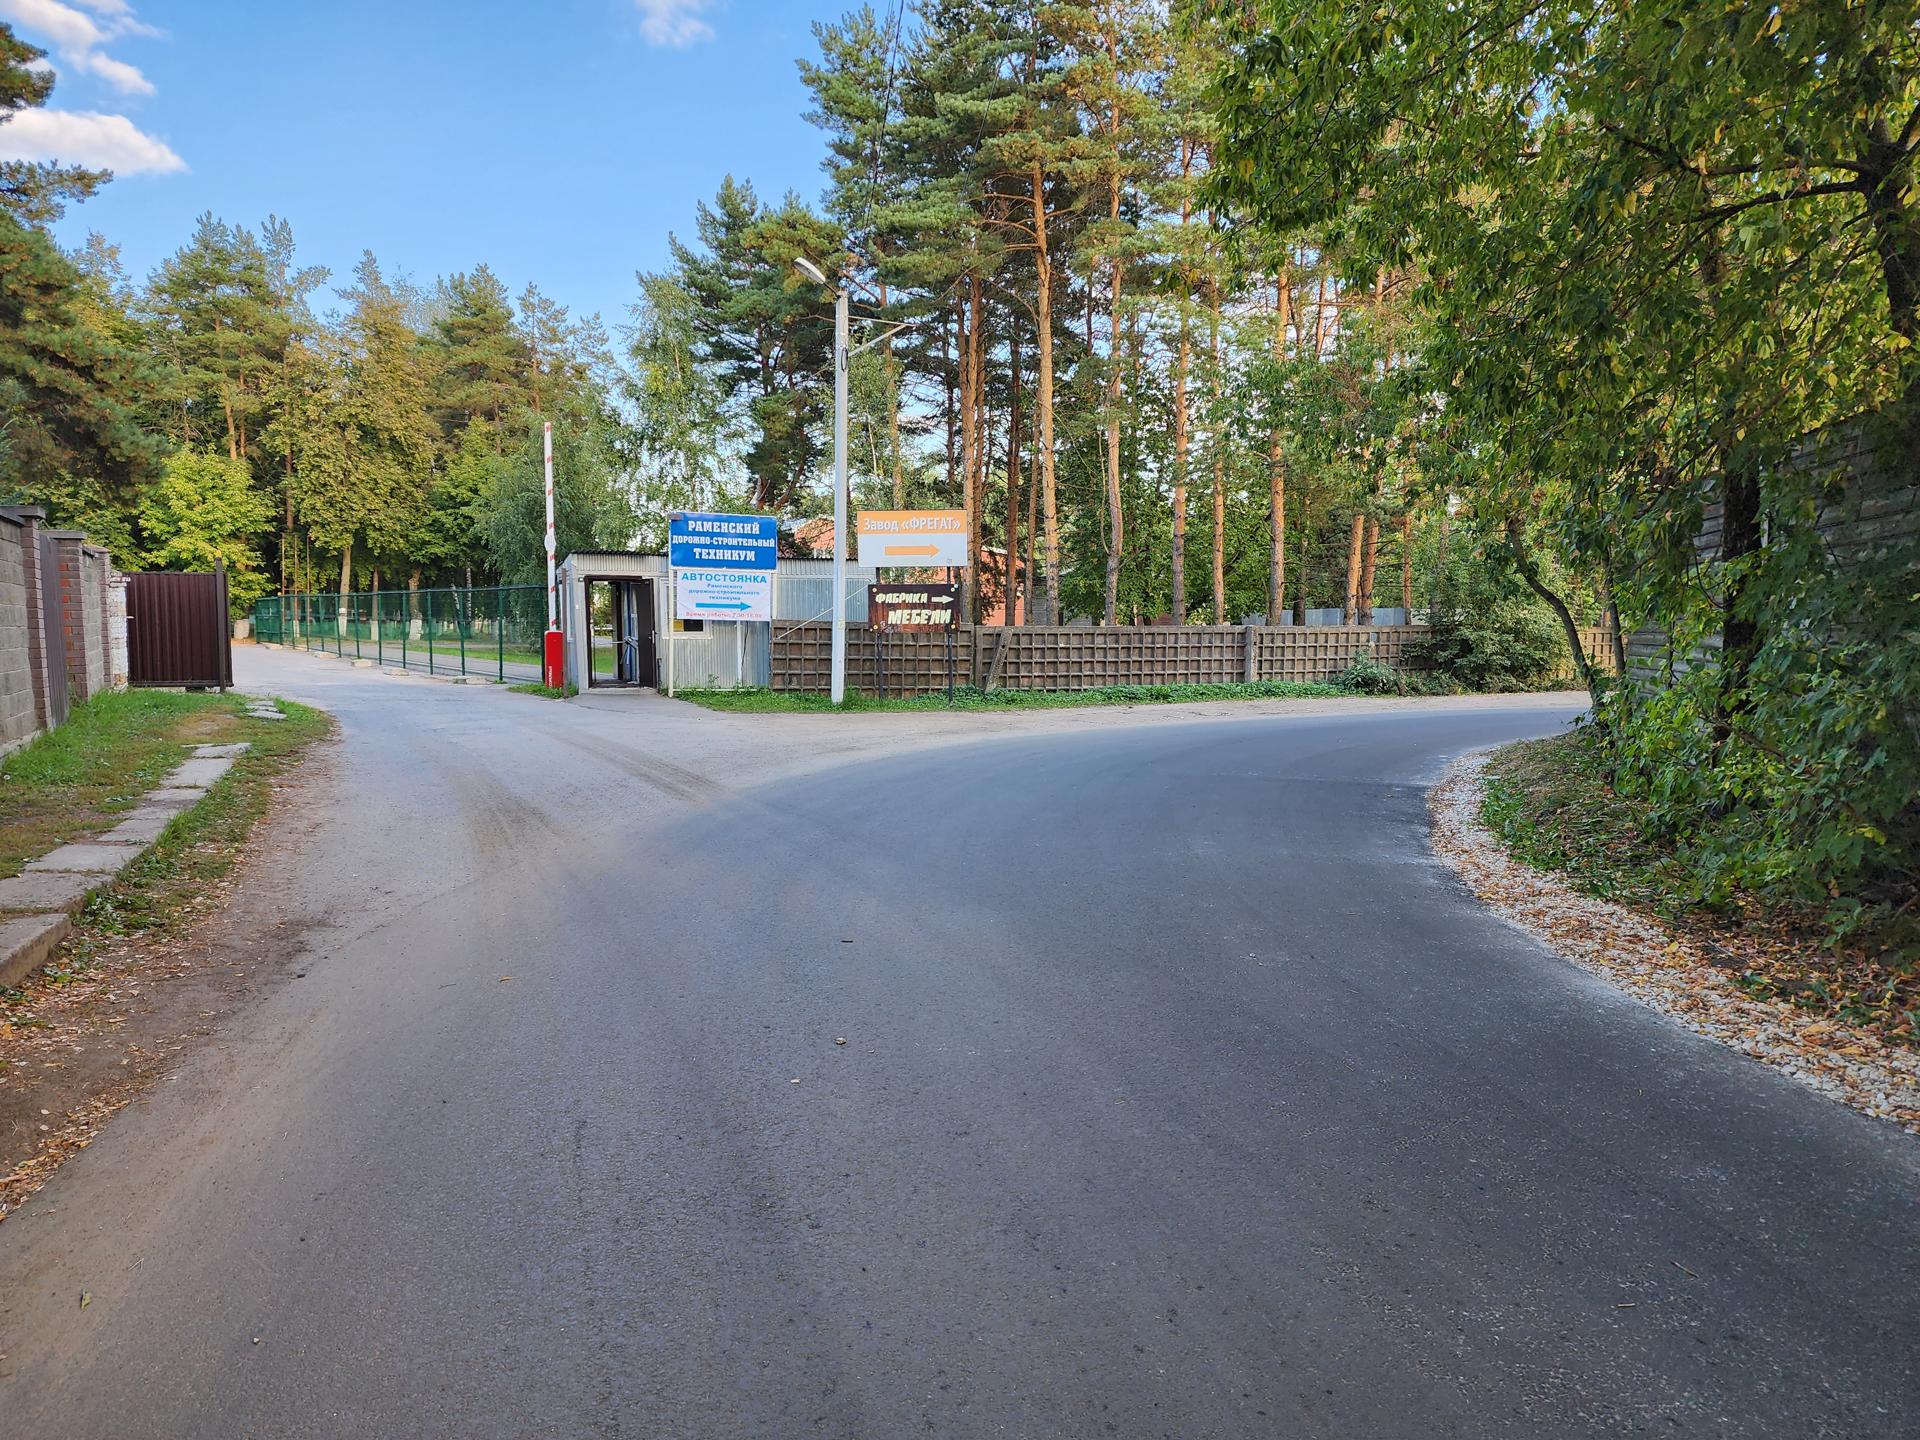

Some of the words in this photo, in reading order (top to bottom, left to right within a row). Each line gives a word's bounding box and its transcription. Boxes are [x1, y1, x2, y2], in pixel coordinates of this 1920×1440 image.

[688, 520, 760, 534] РАМЕНСКИЙ
[863, 518, 899, 531] Завод
[902, 517, 961, 530] «ФРЕГАТ»
[672, 535, 775, 547] ДОРОЖНО-СТРОИТЕЛЬНЫЙ
[693, 548, 755, 561] ТЕХНИКУМ
[681, 572, 767, 584] АВТОСТОЯНКА
[875, 592, 928, 604] ФАБРИКА
[887, 609, 952, 625] МЕБЕЛИ
